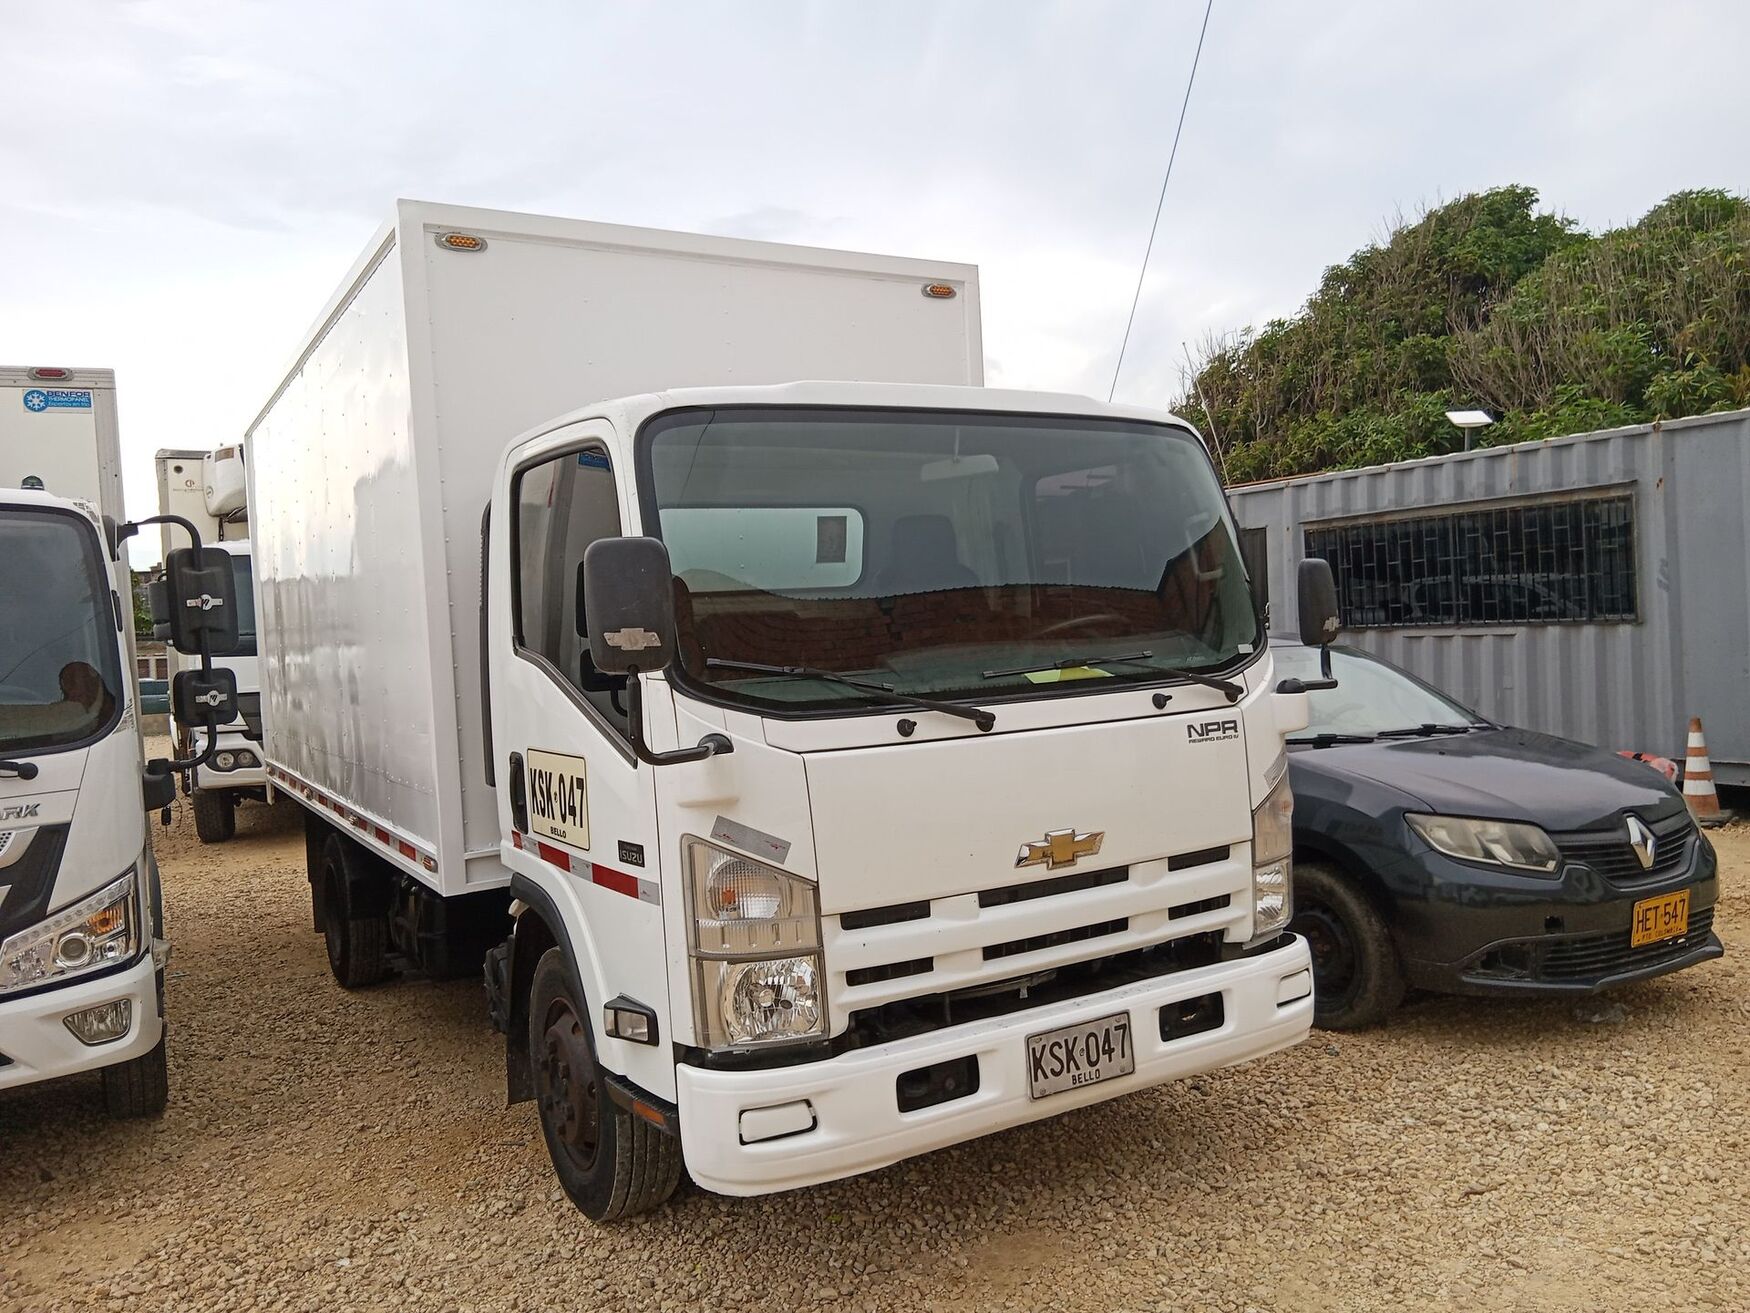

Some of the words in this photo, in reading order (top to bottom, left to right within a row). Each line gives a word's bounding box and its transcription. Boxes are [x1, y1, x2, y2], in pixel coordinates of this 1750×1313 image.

[1187, 720, 1238, 738] NPR
[550, 826, 566, 839] BELLO
[1071, 1068, 1101, 1085] BELLO
